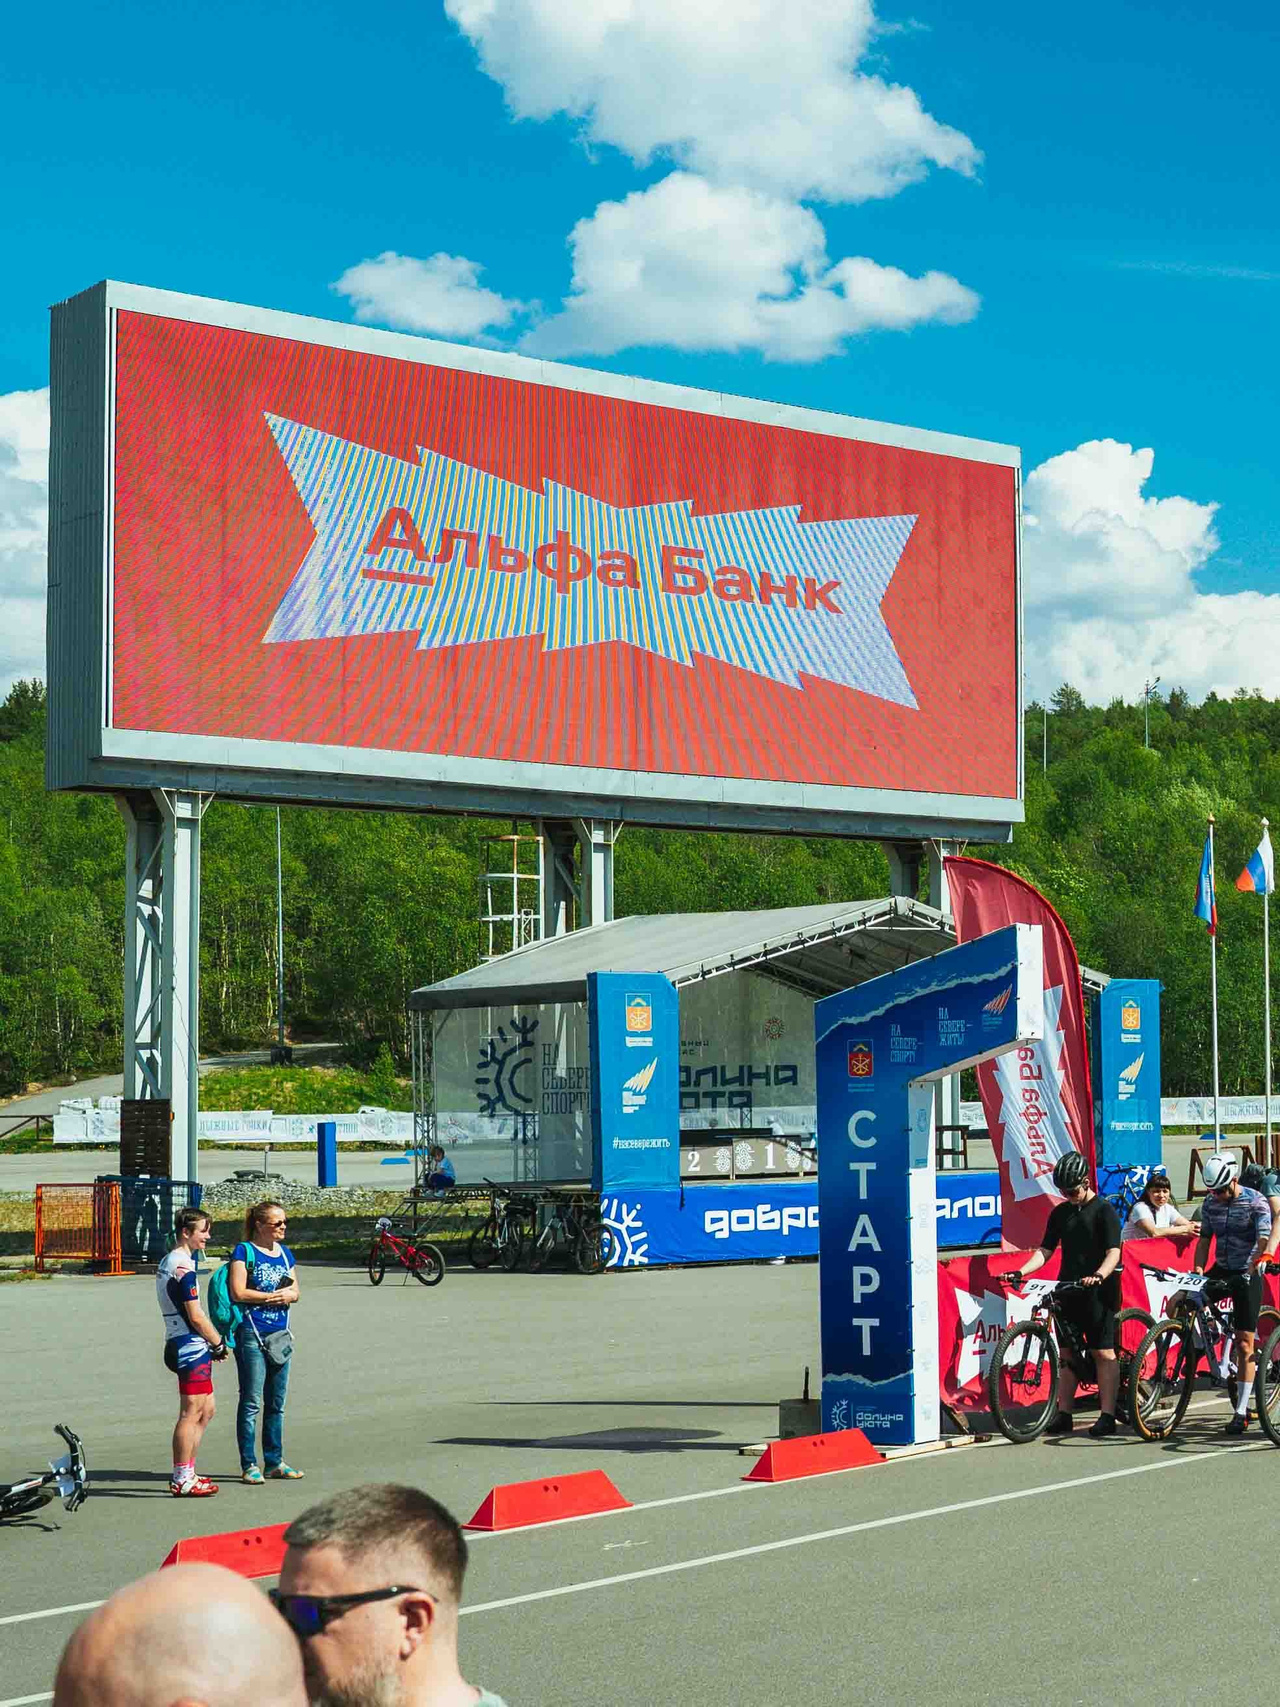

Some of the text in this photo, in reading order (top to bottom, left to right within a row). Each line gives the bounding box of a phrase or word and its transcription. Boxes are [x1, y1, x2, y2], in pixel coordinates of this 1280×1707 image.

[366, 505, 844, 615] Альфа Банк
[938, 1007, 949, 1020] НА
[680, 1064, 798, 1088] олина
[687, 1151, 700, 1172] 2
[765, 1142, 776, 1169] 1
[847, 1110, 882, 1356] СТАРТ
[1030, 1283, 1046, 1292] 91
[1177, 1276, 1202, 1287] 120
